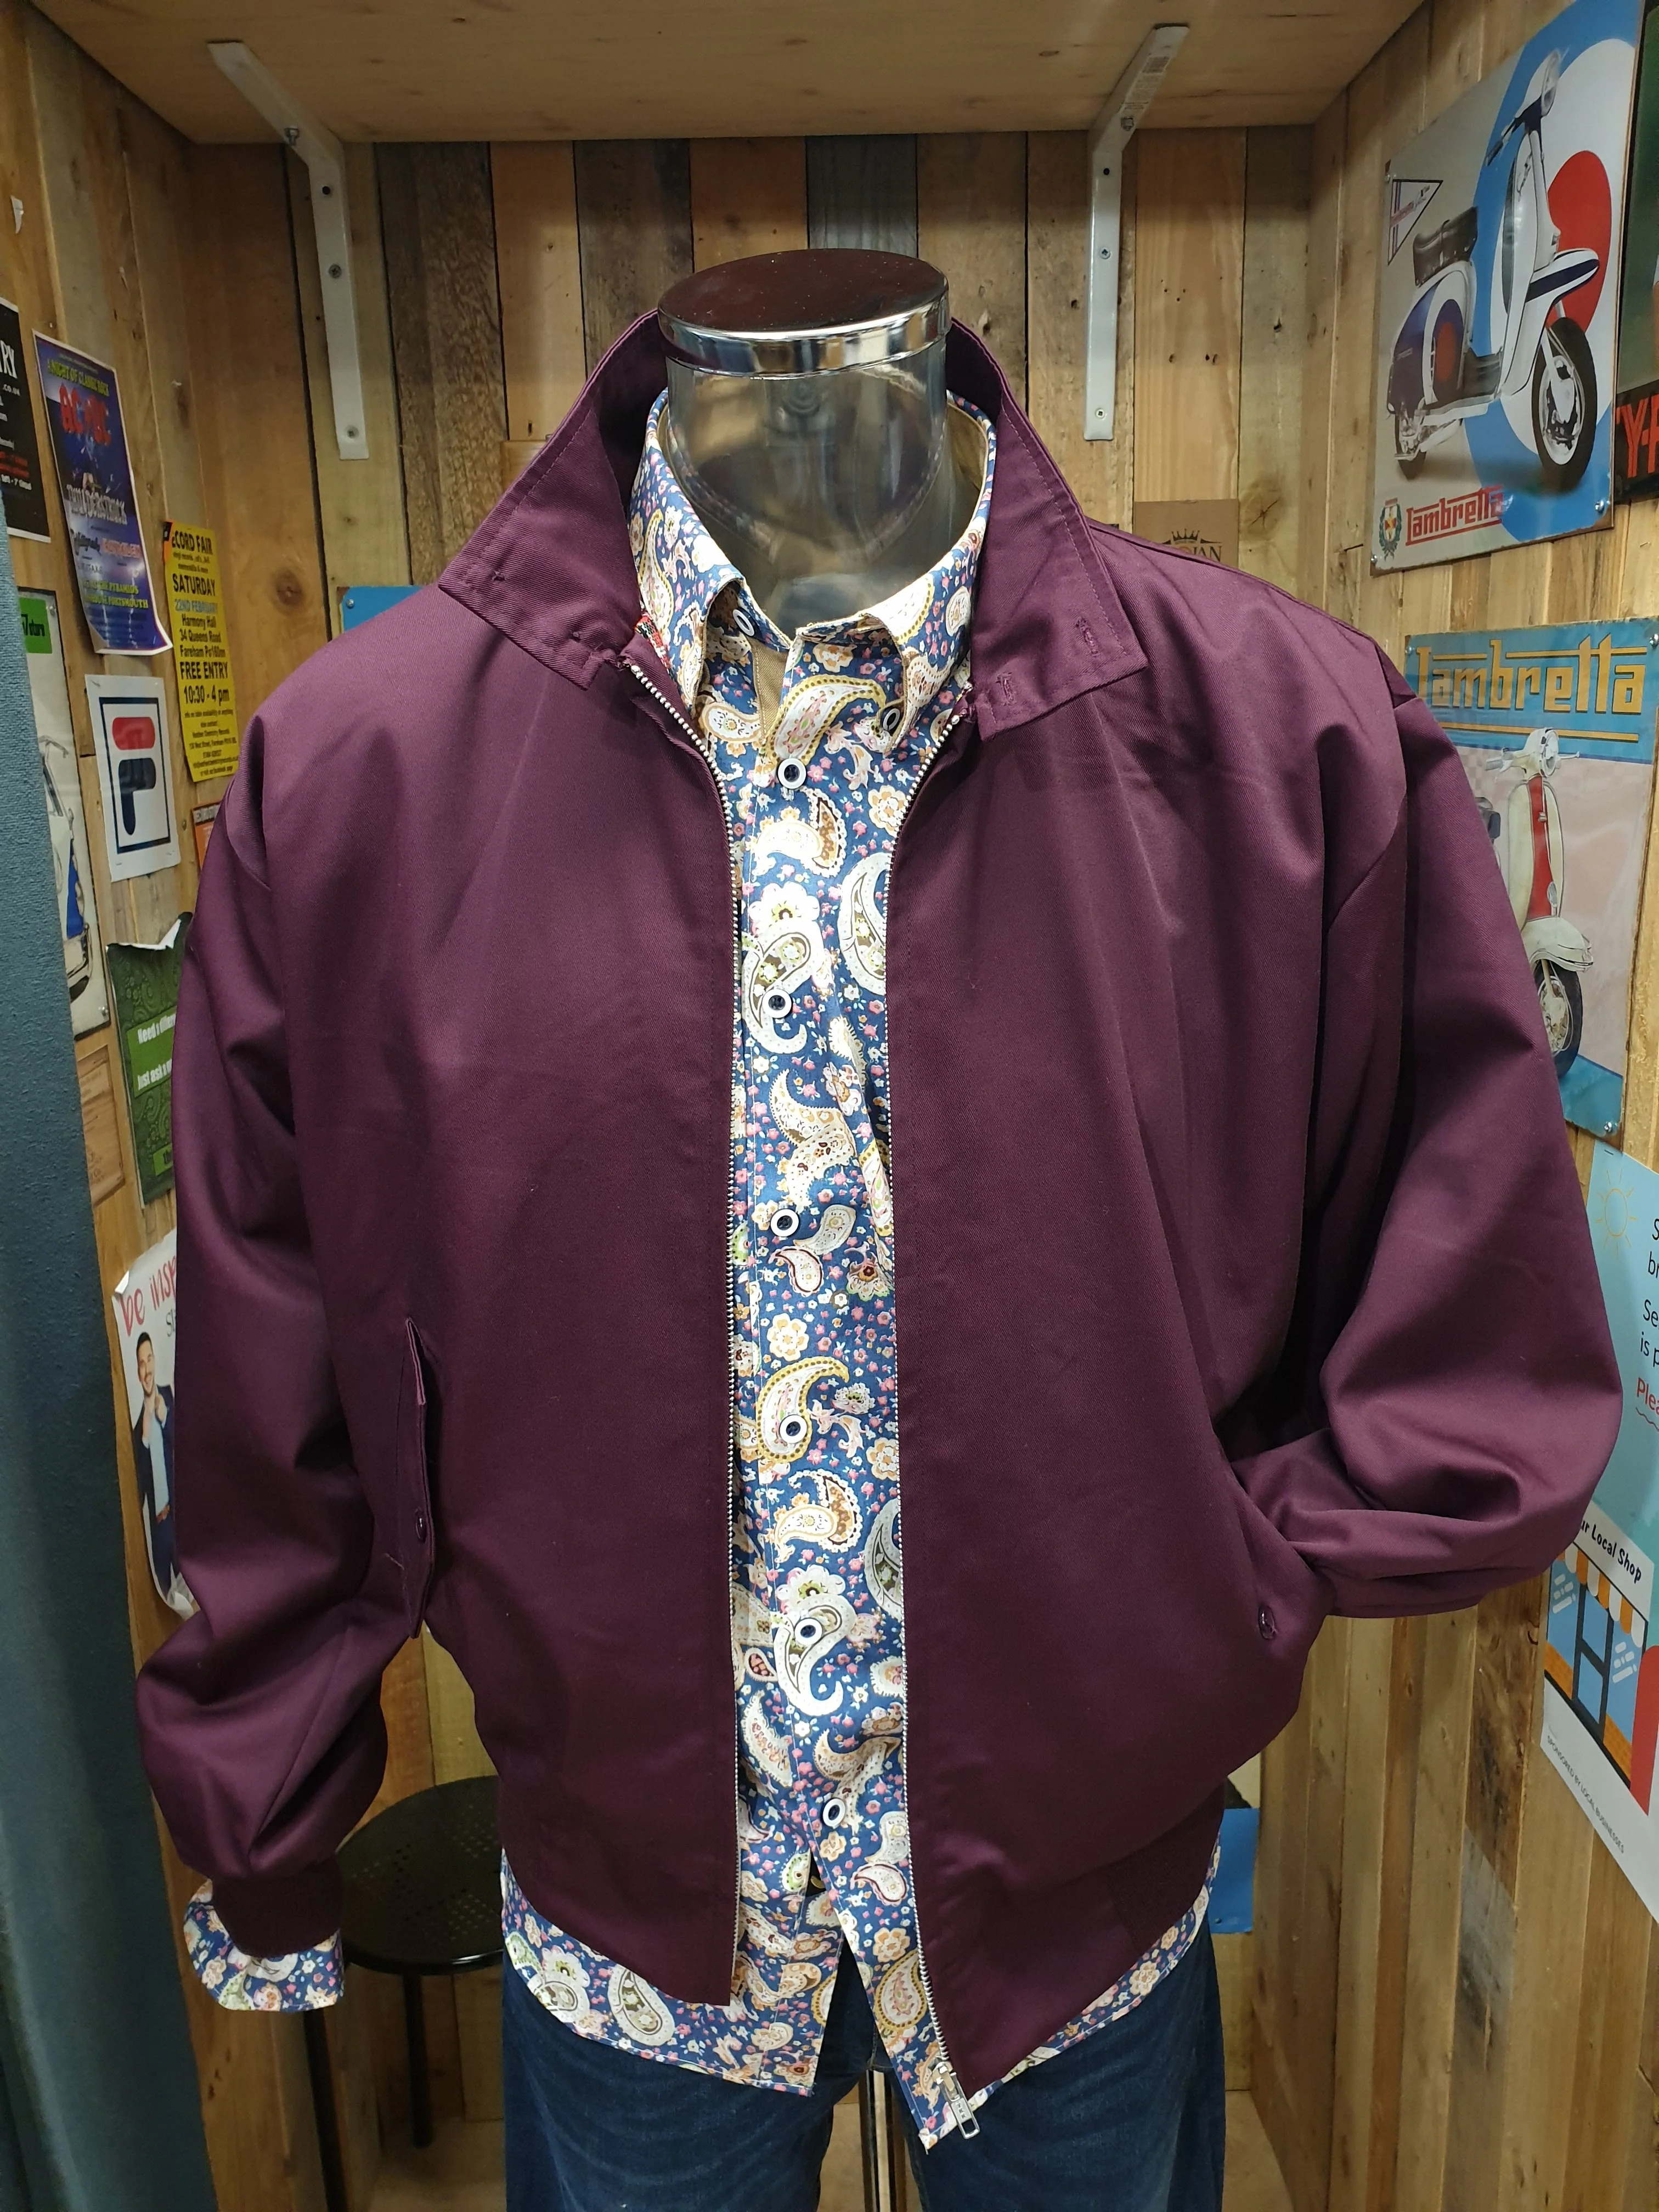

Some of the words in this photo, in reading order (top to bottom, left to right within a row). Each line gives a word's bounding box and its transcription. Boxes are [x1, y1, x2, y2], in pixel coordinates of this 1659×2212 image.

[1406, 484, 1504, 546] Lambretta
[196, 535, 213, 555] FAIR
[172, 573, 215, 596] SATURDAY
[180, 662, 201, 680] FREE
[203, 662, 228, 679] ENTRY
[1416, 633, 1647, 715] Lambretta
[184, 685, 205, 704] 10:30
[218, 689, 229, 706] pm
[149, 1256, 176, 1311] insp
[1640, 1331, 1650, 1356] is
[1592, 1524, 1617, 1558] Local
[1618, 1548, 1641, 1584] Shop
[1548, 1735, 1574, 1777] SPONSORED
[1575, 1775, 1581, 1787] BY
[1581, 1785, 1595, 1811] LOCAL
[1595, 1807, 1624, 1853] BUSINESSES
